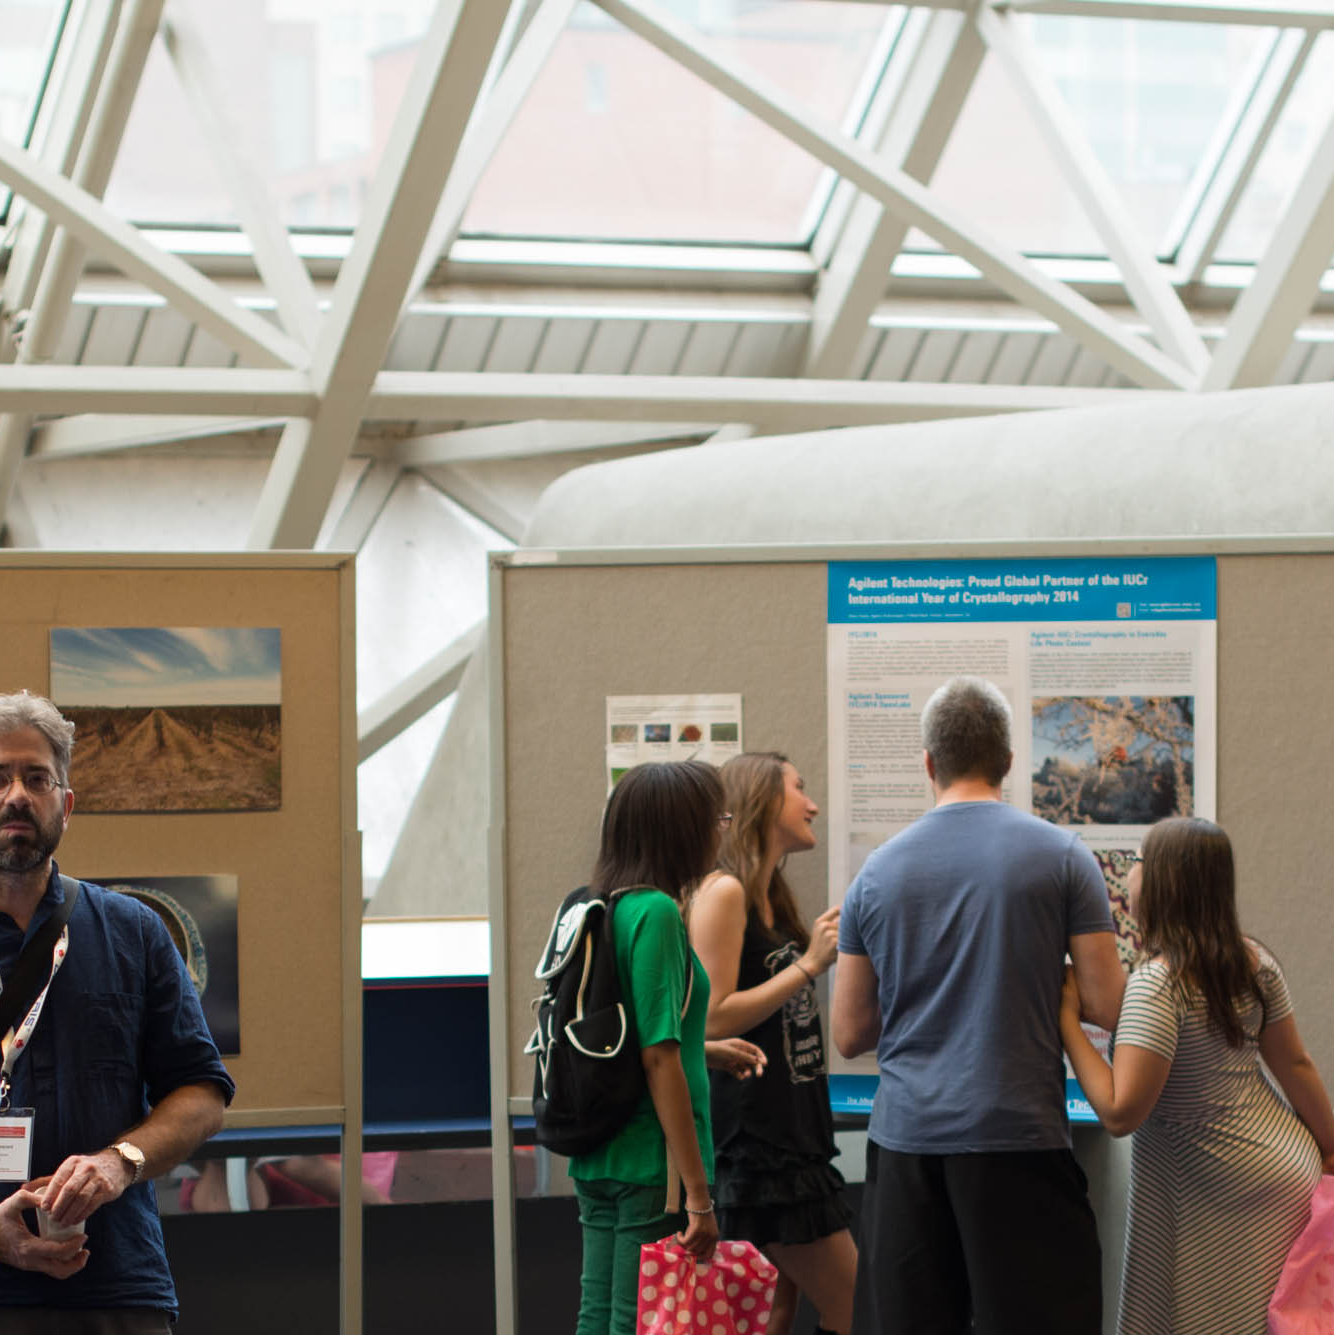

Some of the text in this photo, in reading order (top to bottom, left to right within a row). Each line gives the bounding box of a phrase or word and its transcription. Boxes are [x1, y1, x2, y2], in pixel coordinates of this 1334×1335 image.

[848, 573, 1149, 591] Agilent Technologies: Proud Global Partner of the IUCr
[848, 590, 1079, 605] International Year of Crystallography 2014
